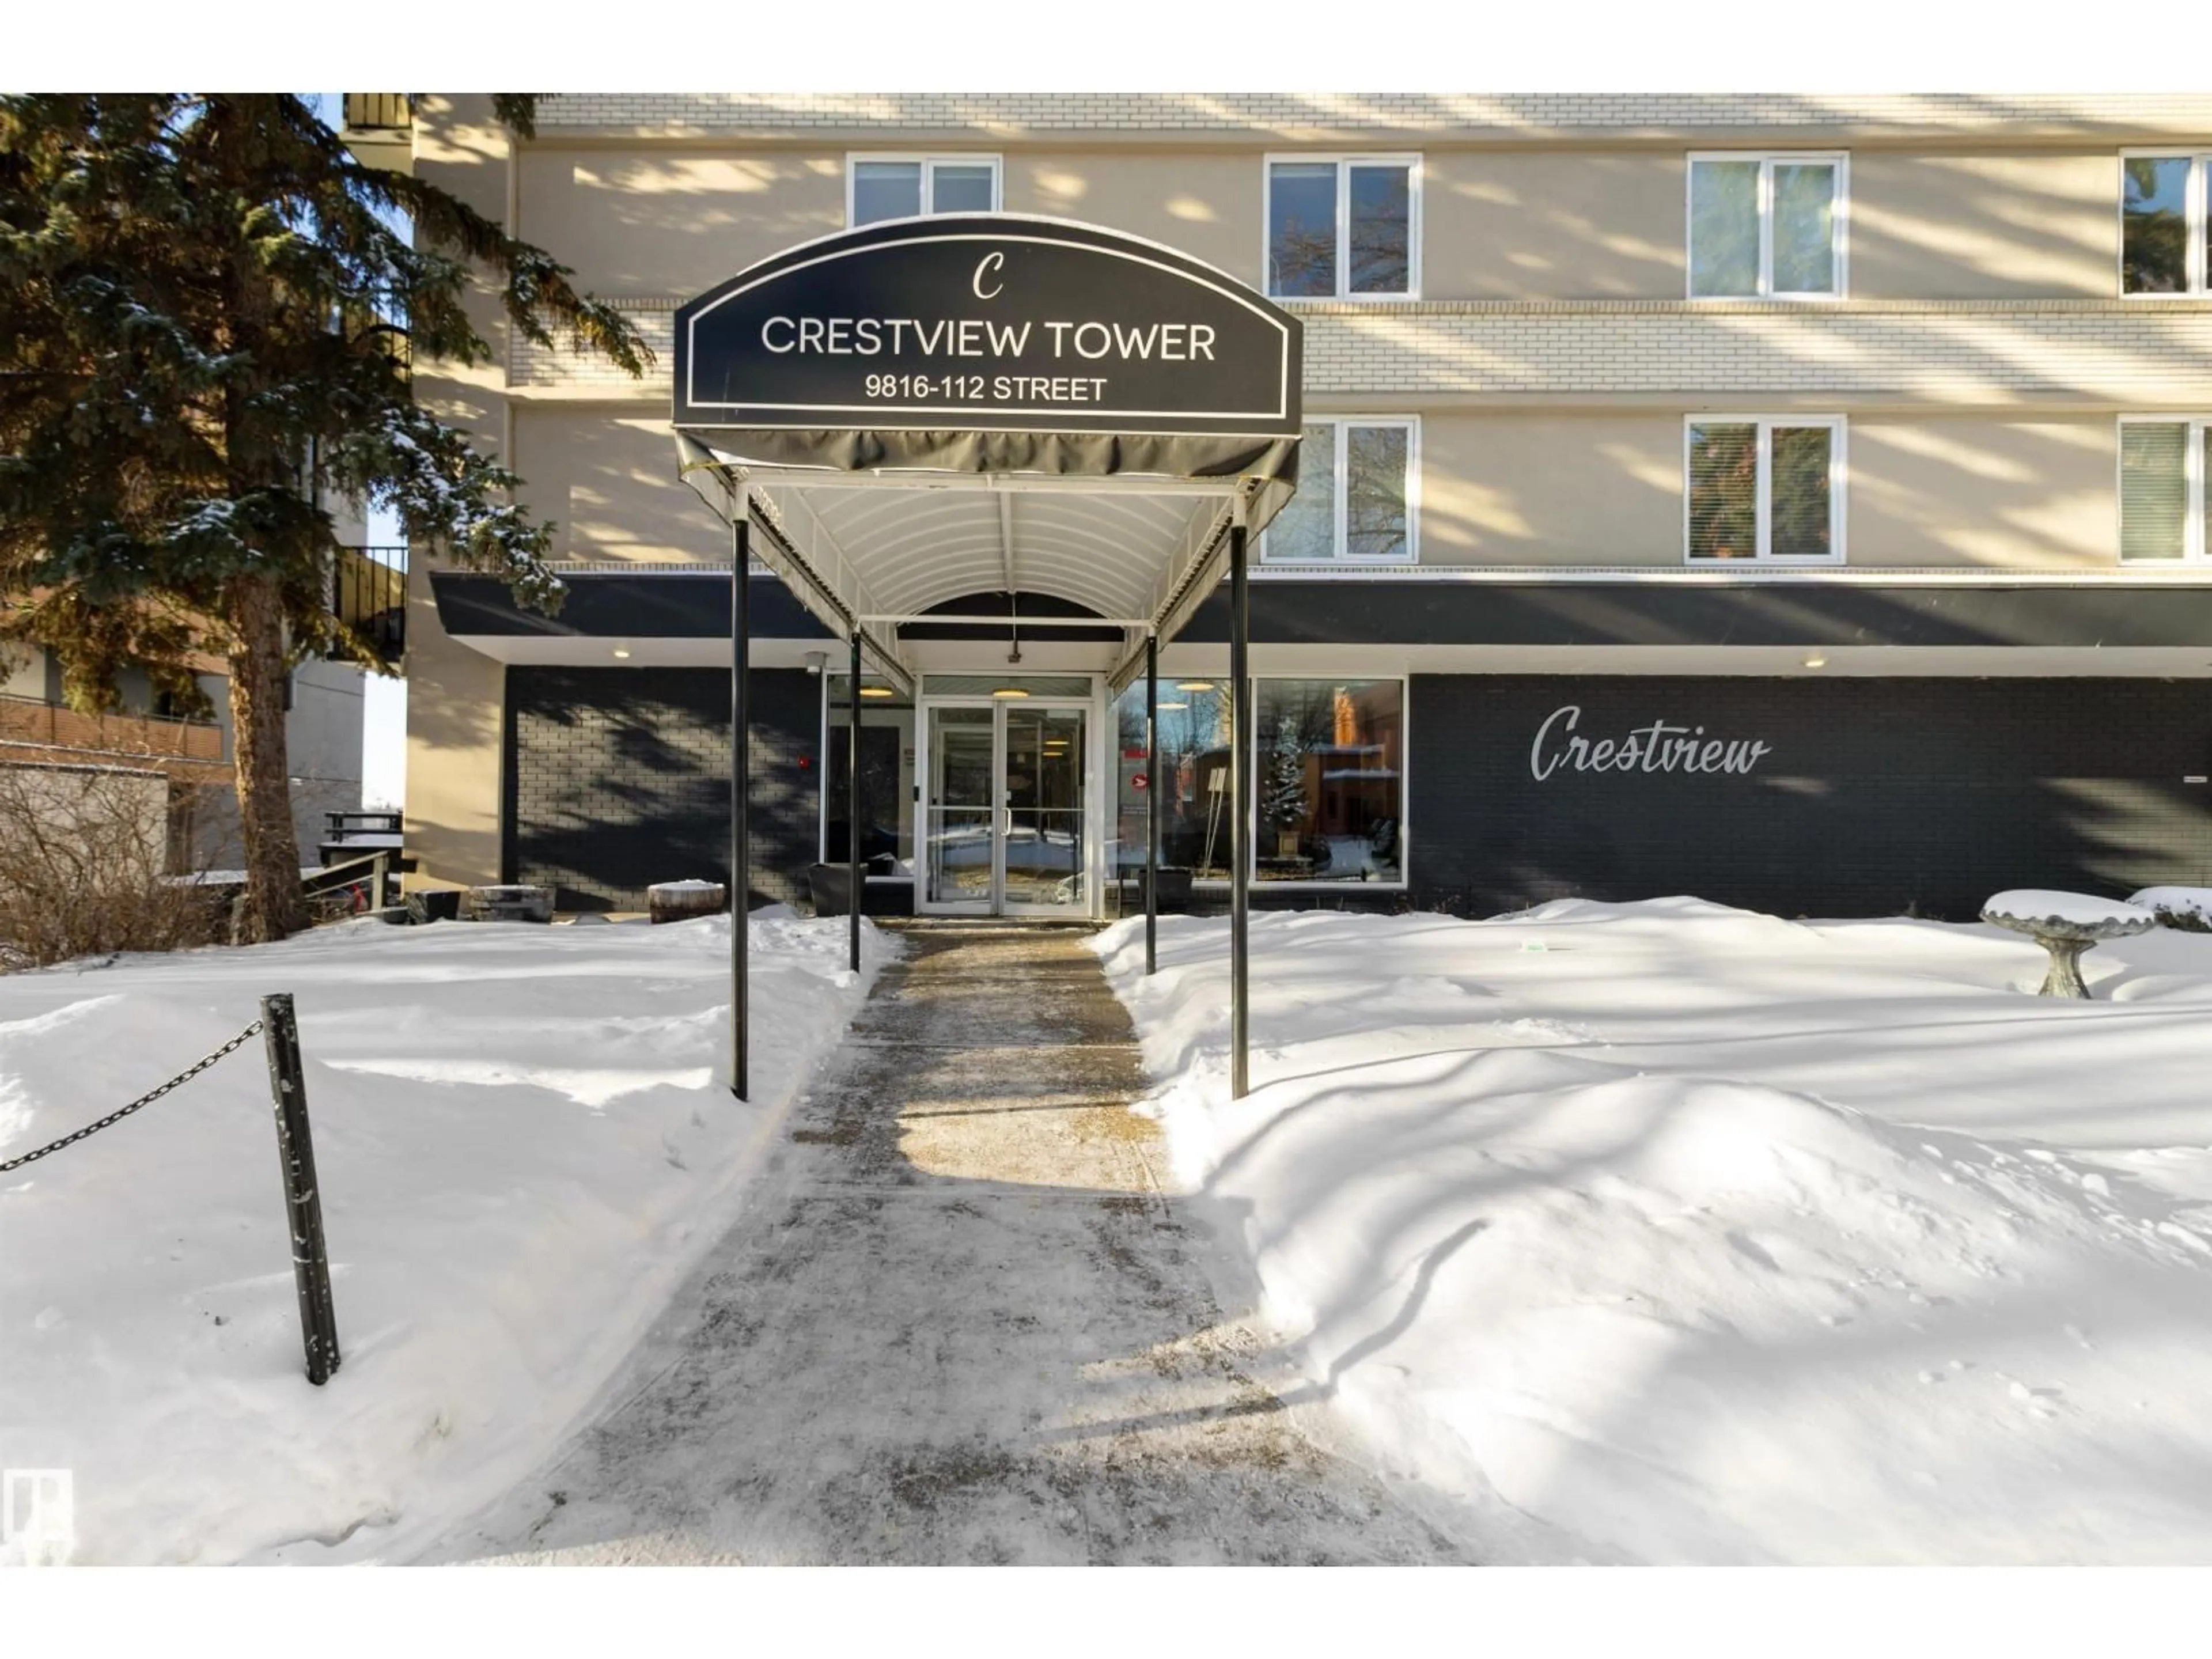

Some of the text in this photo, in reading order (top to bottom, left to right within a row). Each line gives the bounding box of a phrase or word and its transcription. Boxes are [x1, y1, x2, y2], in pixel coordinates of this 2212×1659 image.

[972, 251, 1005, 300] C
[761, 316, 1216, 361] CRESTVIEW TOWER
[865, 373, 1108, 402] 9816-112 STREET
[1530, 704, 1774, 781] Crestview
